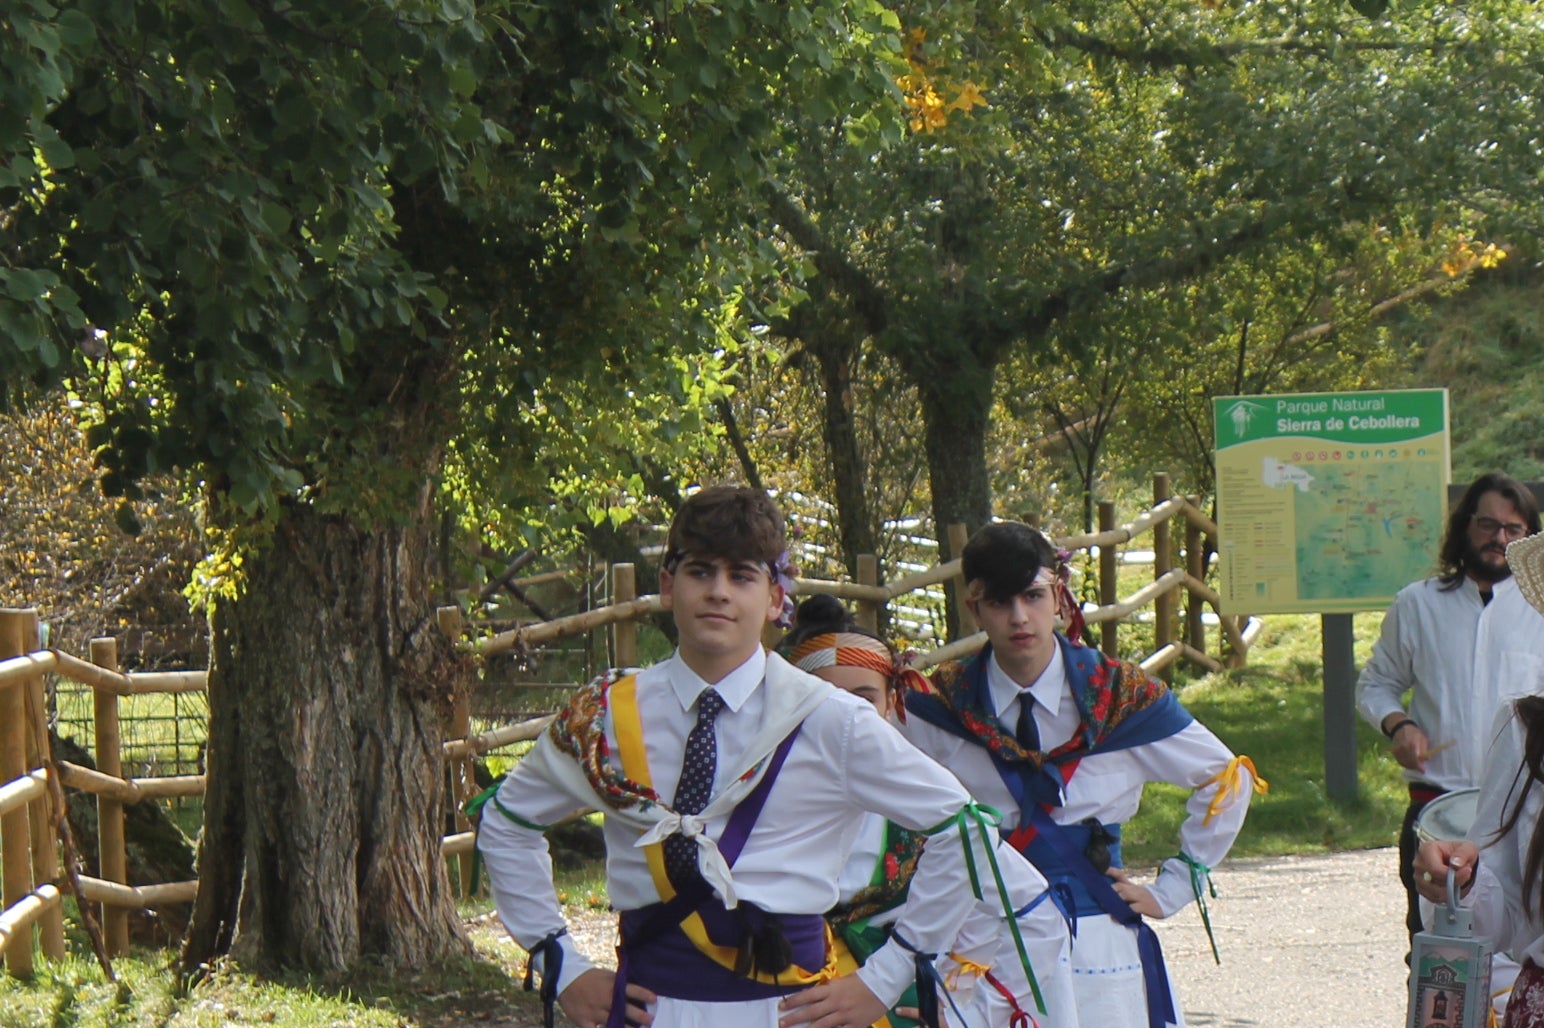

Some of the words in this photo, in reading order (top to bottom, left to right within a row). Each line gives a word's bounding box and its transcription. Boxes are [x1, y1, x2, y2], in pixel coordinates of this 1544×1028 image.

[1276, 399, 1328, 415] Parque
[1332, 397, 1385, 412] Natural
[1277, 417, 1321, 432] Sierra
[1325, 416, 1344, 431] de
[1348, 414, 1420, 430] Cebollera
